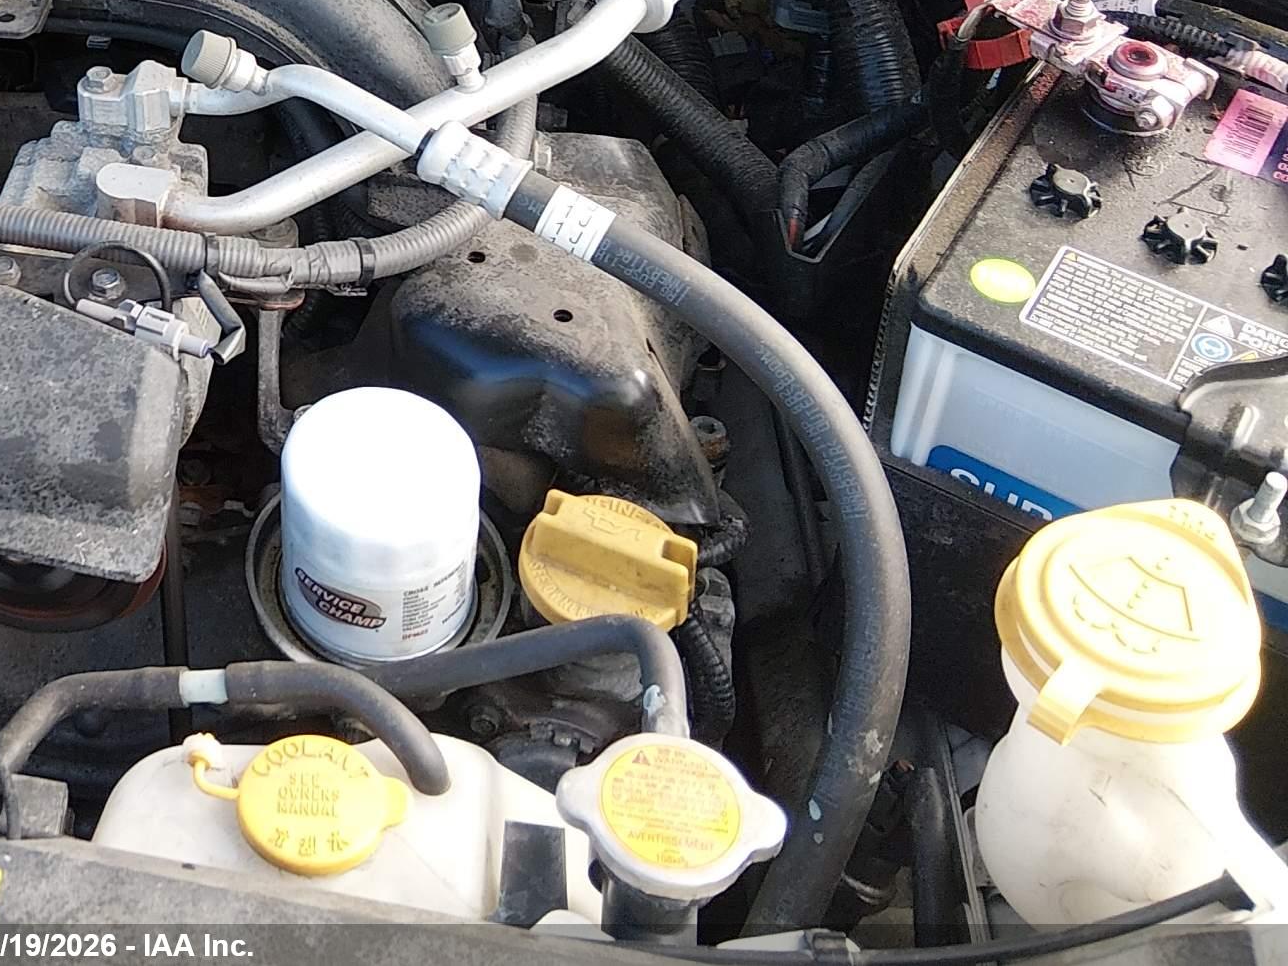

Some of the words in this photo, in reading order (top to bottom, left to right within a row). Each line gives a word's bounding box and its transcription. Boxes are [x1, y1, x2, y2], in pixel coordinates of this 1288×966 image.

[297, 570, 364, 614] SERVICE
[317, 600, 385, 628] CHAMP
[252, 738, 369, 778] COOLANT
[289, 773, 320, 787] SEE
[277, 801, 339, 819] MANUAL
